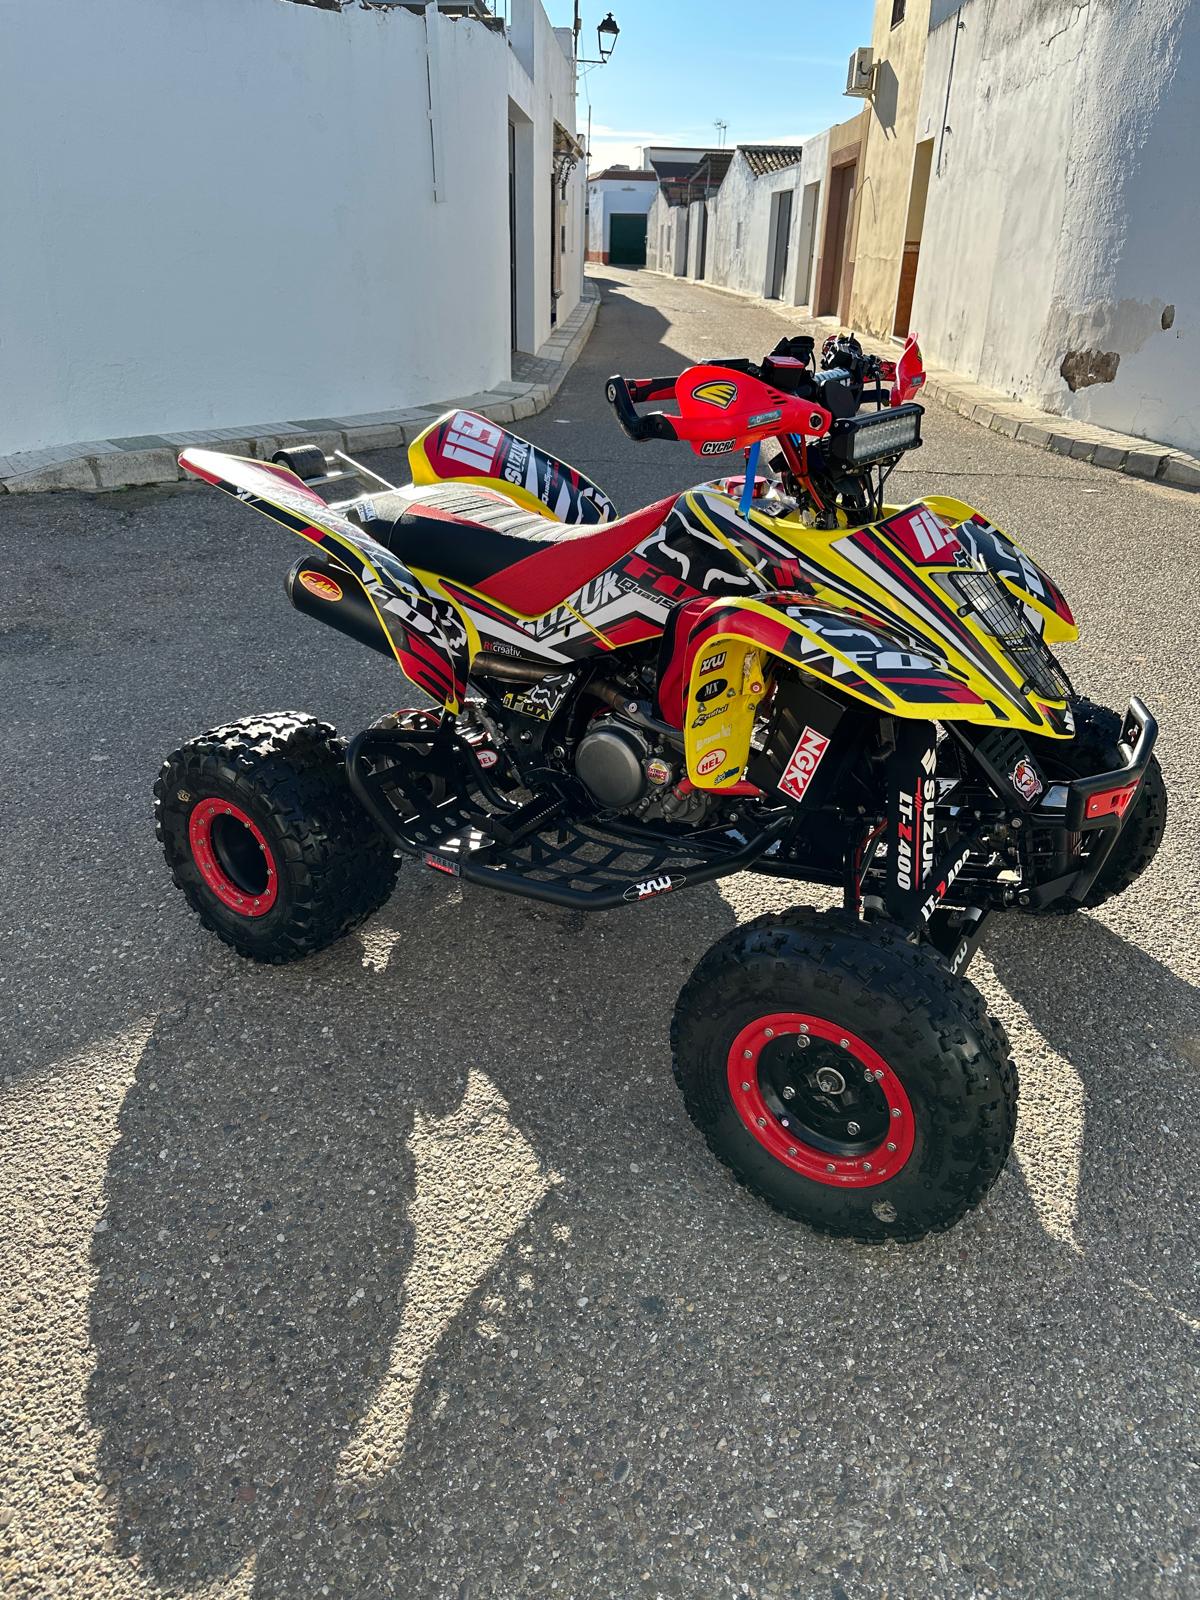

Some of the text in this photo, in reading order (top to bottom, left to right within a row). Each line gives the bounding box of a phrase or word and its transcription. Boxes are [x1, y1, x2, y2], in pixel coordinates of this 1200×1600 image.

[504, 438, 529, 486] SUZUK
[302, 574, 340, 597] FMF
[704, 681, 720, 697] MX
[701, 757, 722, 772] HEL
[785, 729, 826, 790] NGK
[896, 791, 914, 891] LT-Z400
